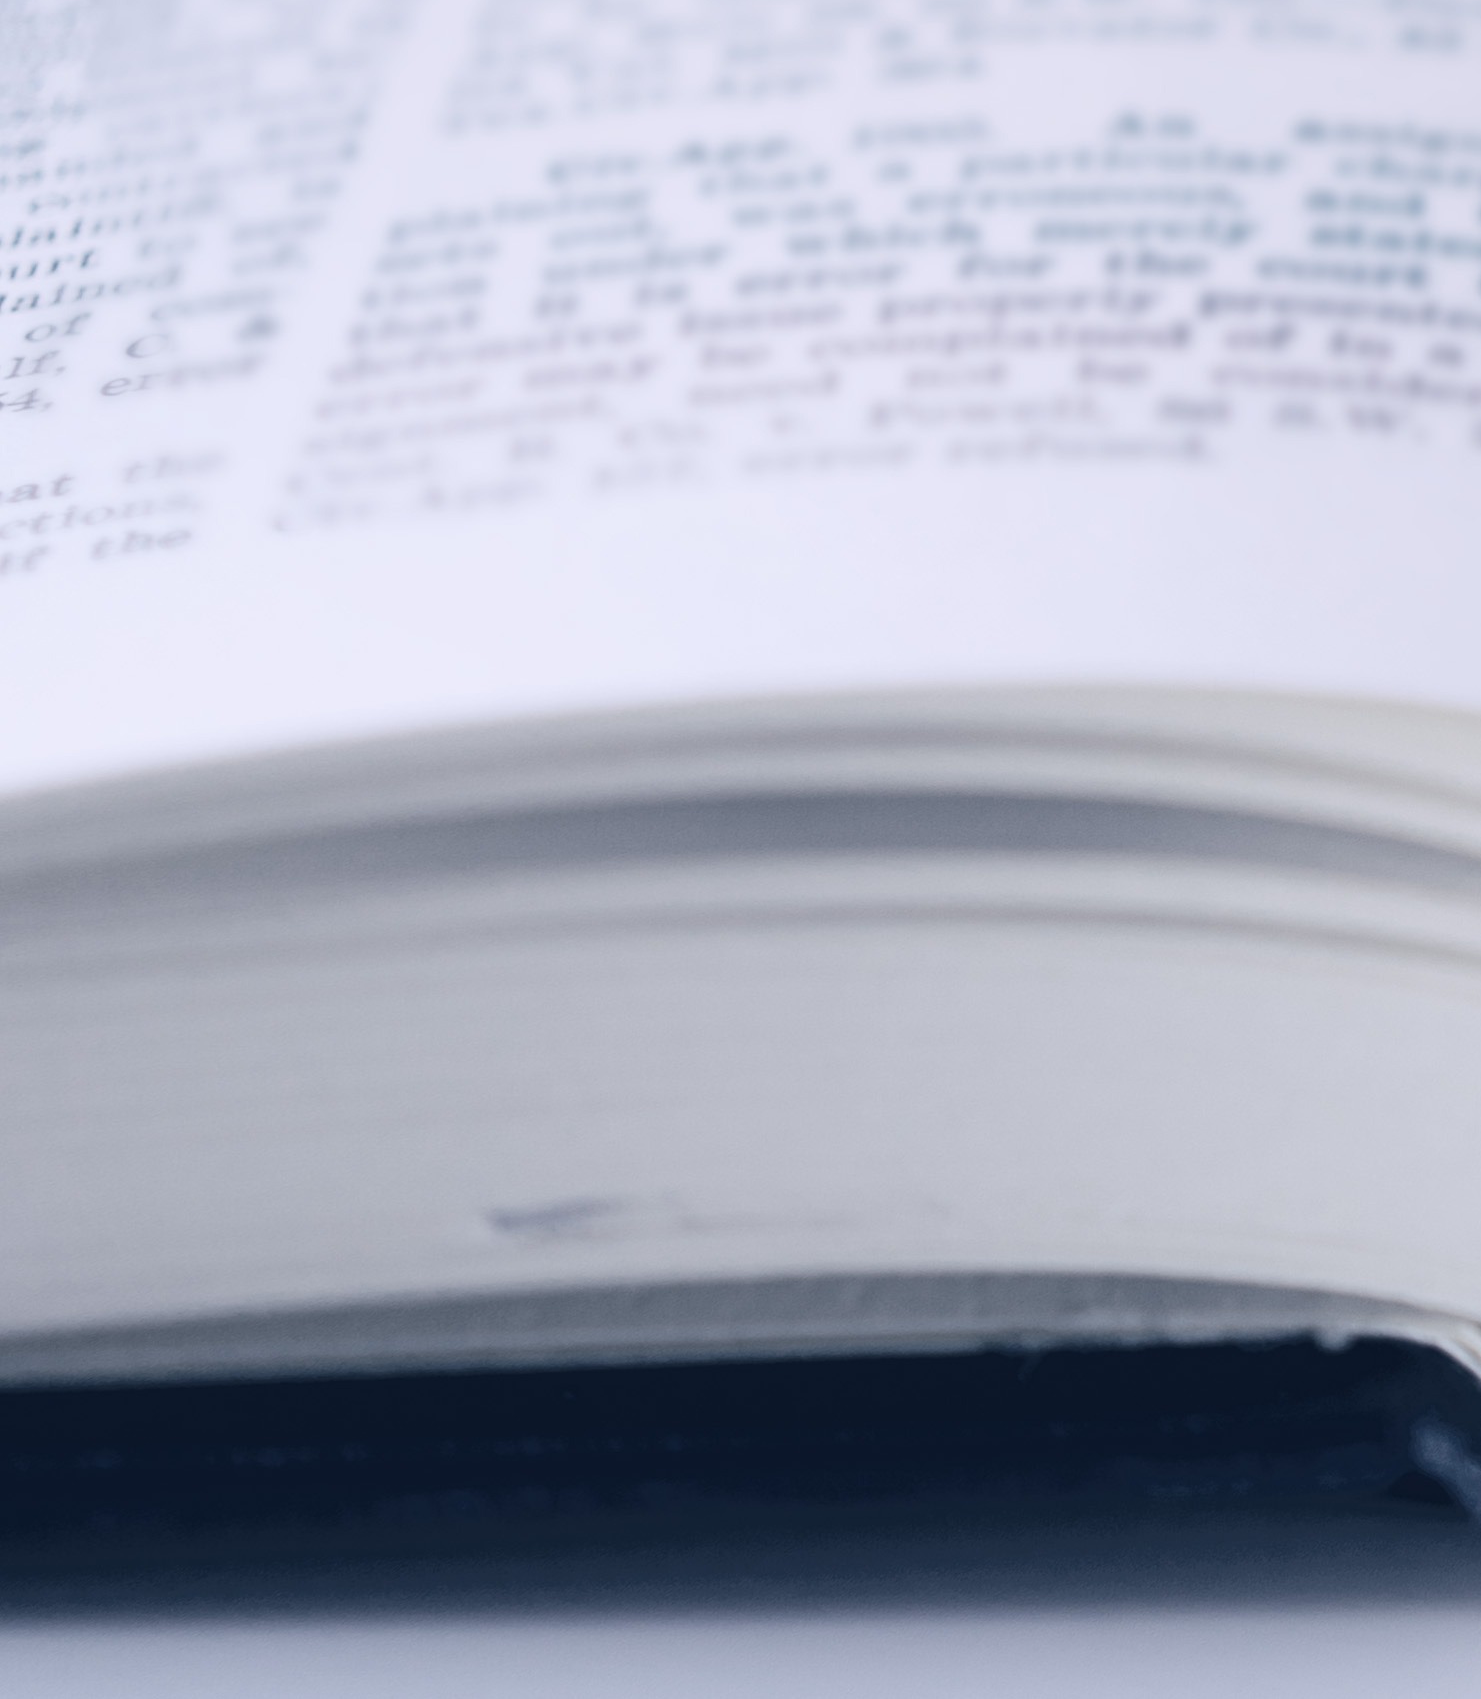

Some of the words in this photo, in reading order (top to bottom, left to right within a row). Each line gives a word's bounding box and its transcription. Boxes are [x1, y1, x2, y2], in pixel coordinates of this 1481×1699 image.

[1110, 110, 1196, 139] An
[698, 163, 830, 197] that
[959, 149, 1290, 182] particular
[1306, 189, 1427, 219] and
[540, 241, 731, 286] under
[784, 215, 981, 259] which
[1033, 214, 1256, 247] merely
[347, 305, 483, 349] that
[732, 263, 902, 297] error
[957, 254, 1056, 281] for
[1104, 250, 1211, 279] the
[1255, 256, 1427, 289] court
[878, 289, 1161, 328] properly
[24, 311, 93, 343] of
[521, 352, 661, 391] may
[699, 341, 772, 371] be
[806, 319, 1192, 363] complained
[1221, 322, 1297, 351] of
[1329, 330, 1395, 361] in
[905, 361, 1007, 389] not
[1075, 357, 1150, 384] be
[122, 451, 228, 488] the
[90, 526, 194, 562] the
